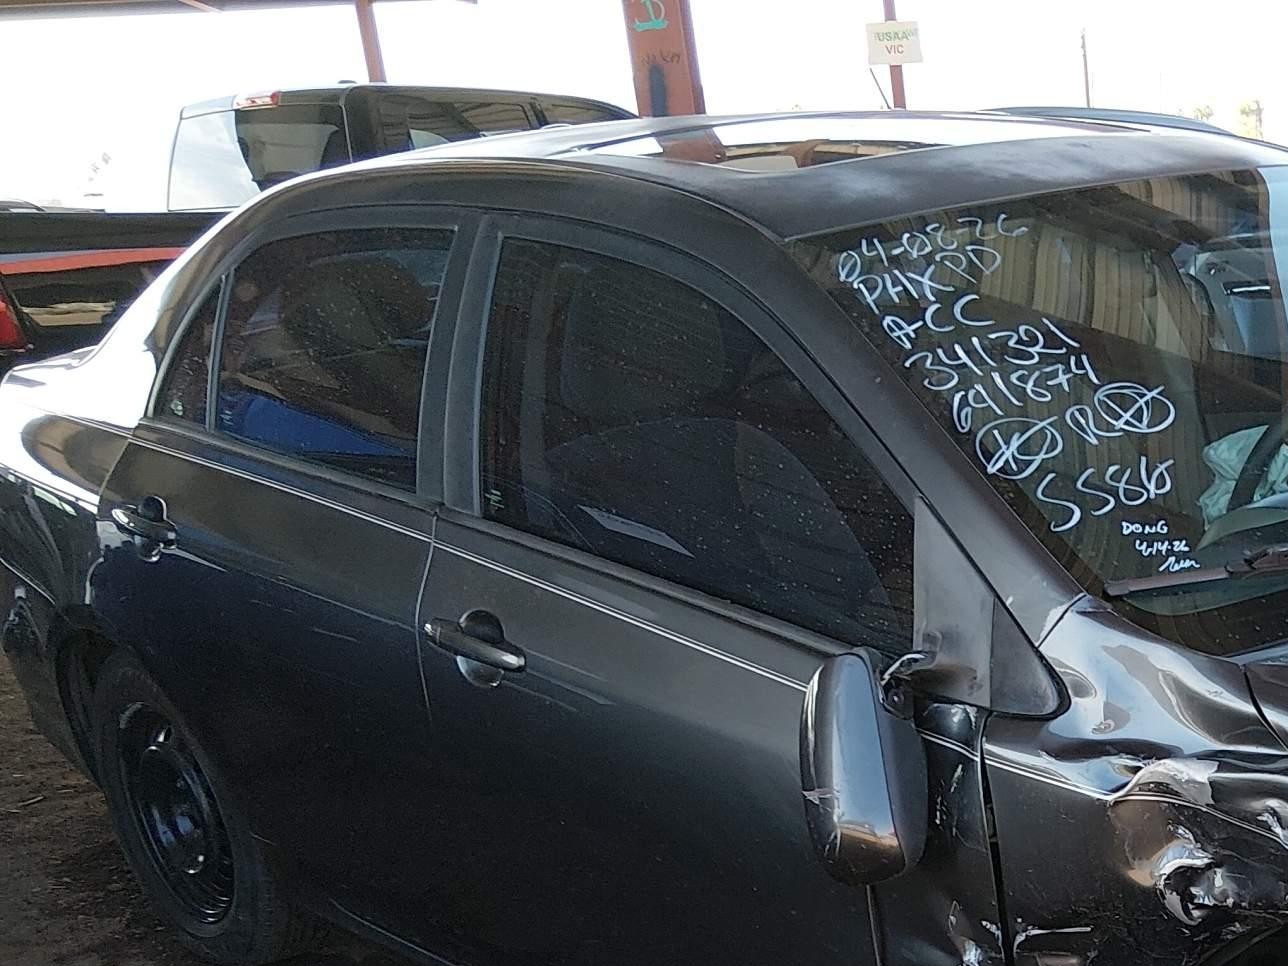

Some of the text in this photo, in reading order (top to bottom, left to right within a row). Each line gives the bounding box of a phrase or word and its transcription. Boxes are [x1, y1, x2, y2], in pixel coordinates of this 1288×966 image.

[884, 43, 905, 55] VIC
[852, 244, 1002, 315] PHX PD
[882, 294, 996, 350] ACC
[903, 316, 1081, 391] 341321
[1121, 520, 1169, 536] DONG
